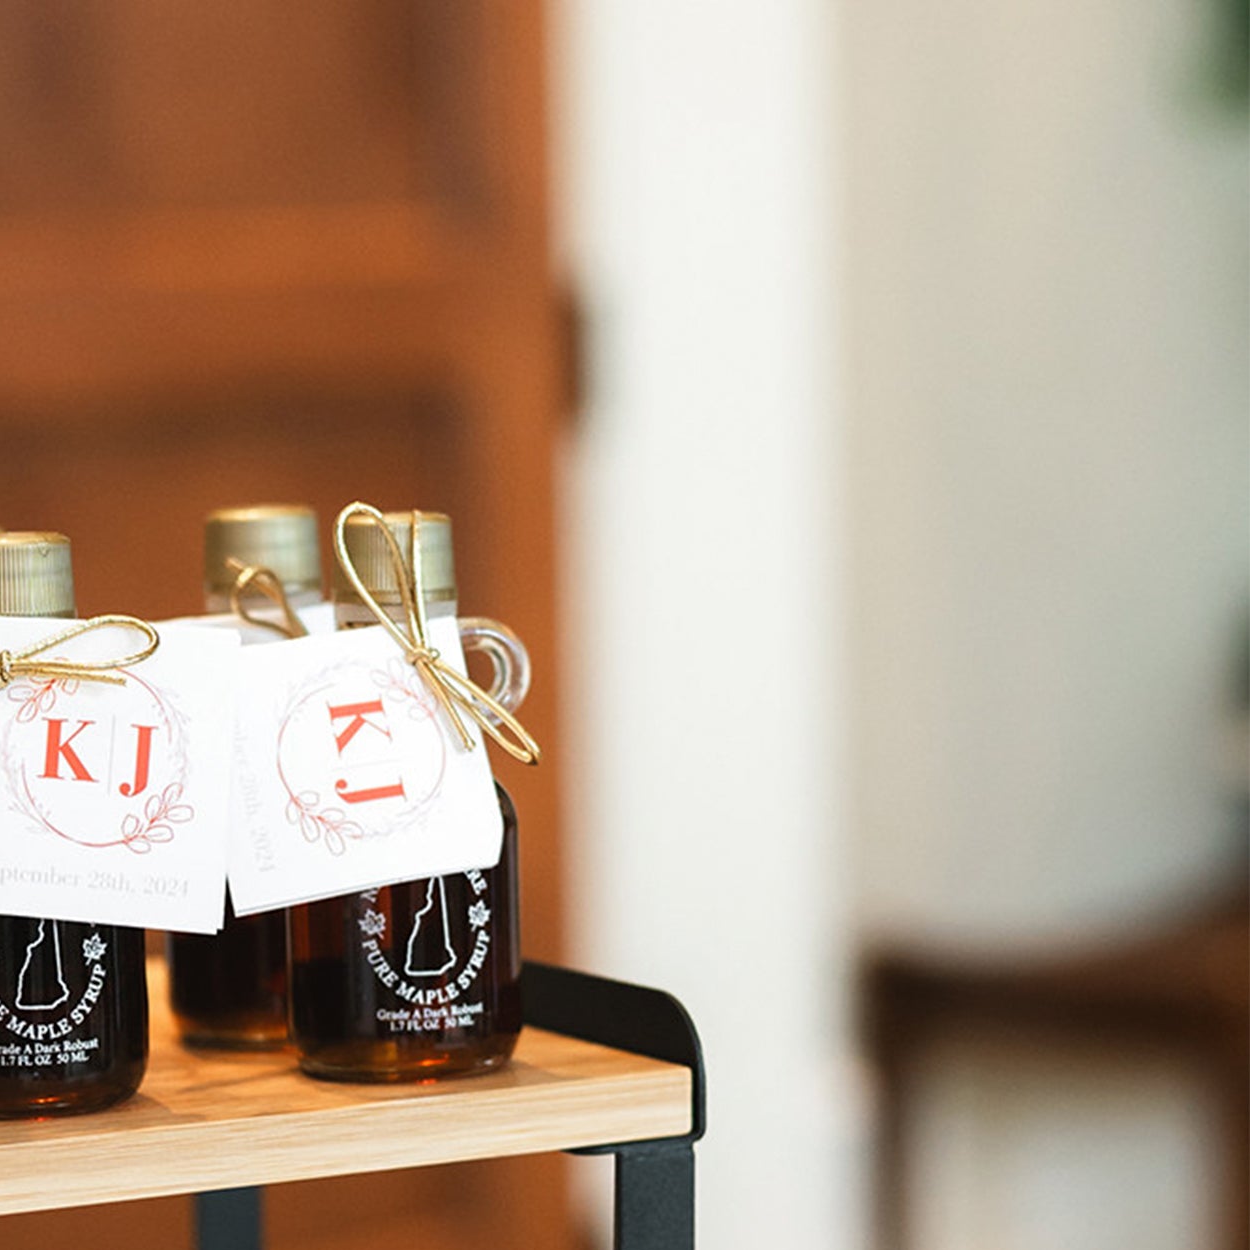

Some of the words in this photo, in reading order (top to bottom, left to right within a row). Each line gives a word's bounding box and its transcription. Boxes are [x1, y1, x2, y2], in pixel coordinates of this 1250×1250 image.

[326, 693, 393, 758] K
[37, 717, 99, 783] K
[119, 723, 159, 798] J
[334, 776, 408, 805] J
[87, 871, 135, 894] 28th,
[143, 874, 190, 897] 2024
[362, 940, 400, 988] PURE
[395, 981, 460, 1005] MAPLE
[457, 930, 491, 990] SYRUP
[6, 1015, 73, 1040] MAPLE
[70, 964, 107, 1025] SYRUP
[413, 1009, 421, 1019] A
[0, 1056, 15, 1067] 1.7
[18, 1055, 33, 1066] FL
[34, 1054, 53, 1066] OZ
[56, 1053, 69, 1064] 50
[71, 1051, 90, 1062] ML
[23, 1044, 32, 1054] A
[34, 1042, 61, 1054] Dark
[63, 1037, 99, 1051] Robust
